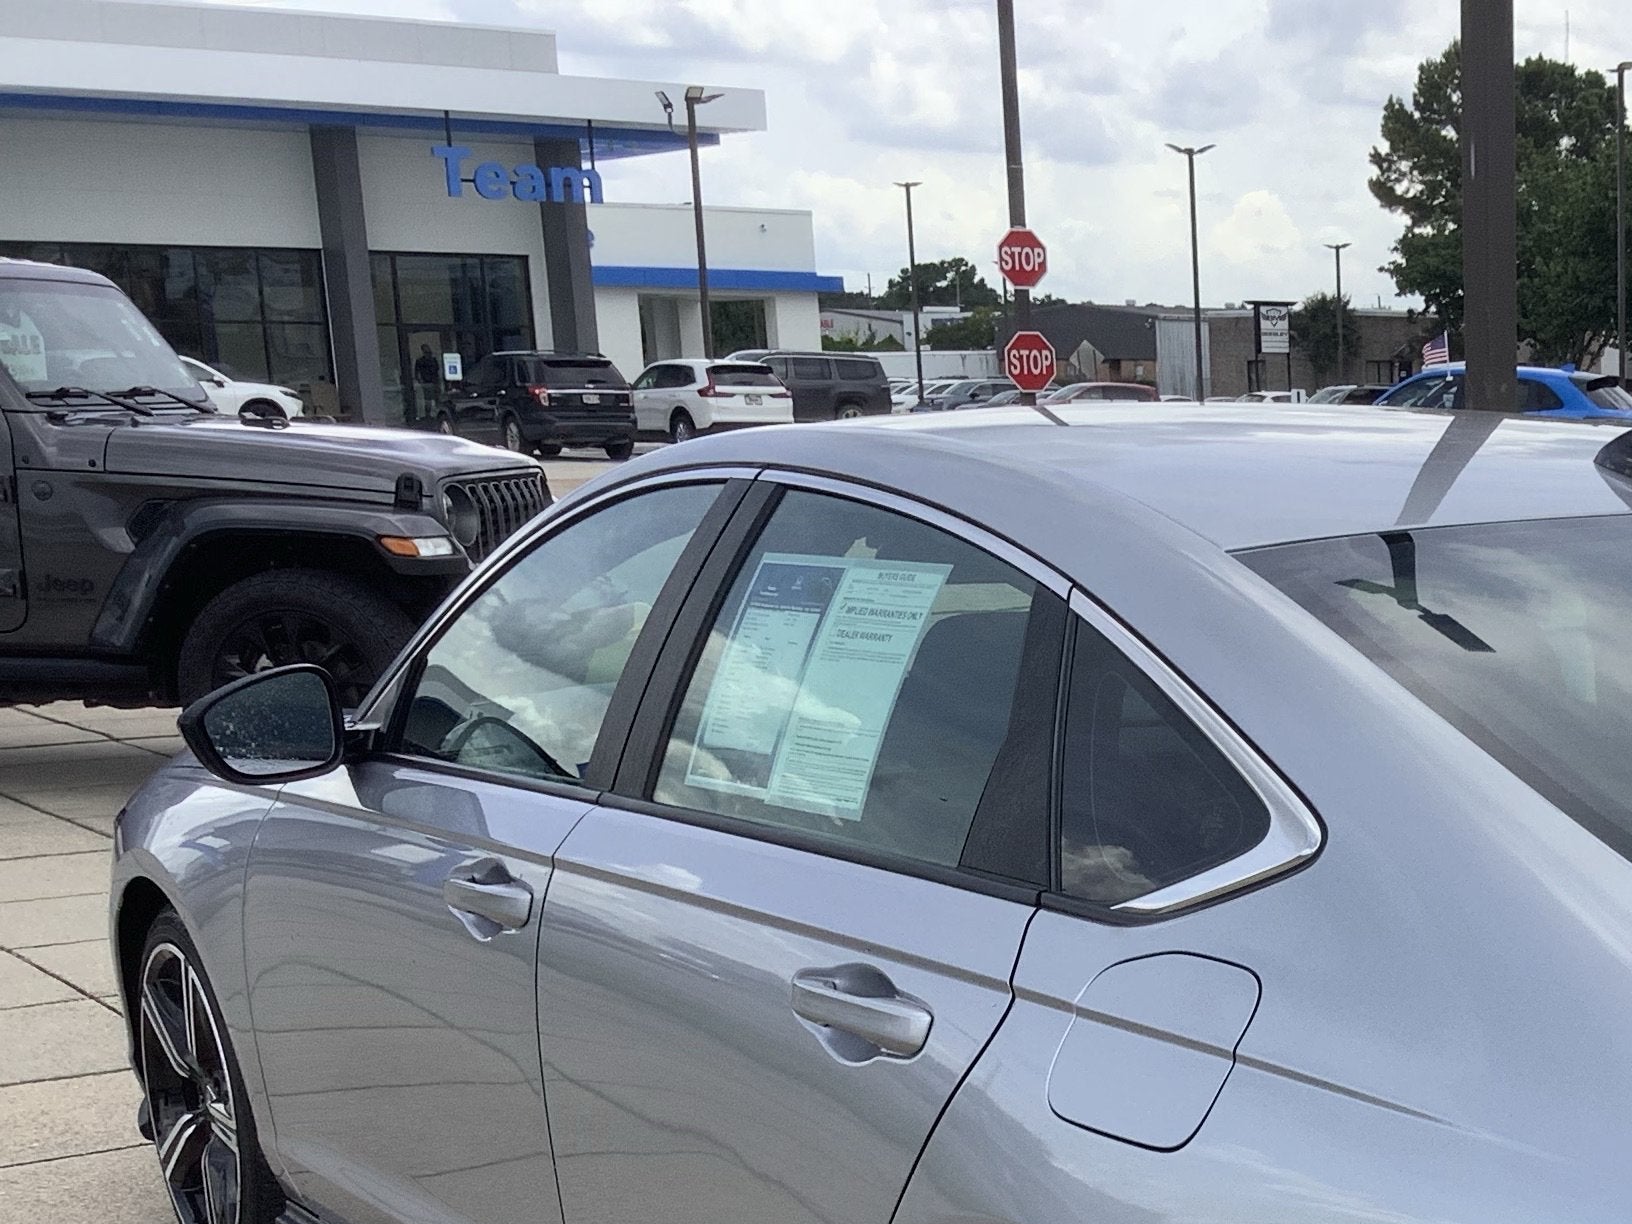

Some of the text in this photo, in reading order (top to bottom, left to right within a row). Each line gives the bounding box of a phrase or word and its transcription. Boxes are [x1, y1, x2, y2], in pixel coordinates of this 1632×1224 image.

[431, 145, 603, 203] Team
[1001, 246, 1044, 272] STOP
[1010, 349, 1051, 375] STOP
[37, 574, 94, 595] Jeep
